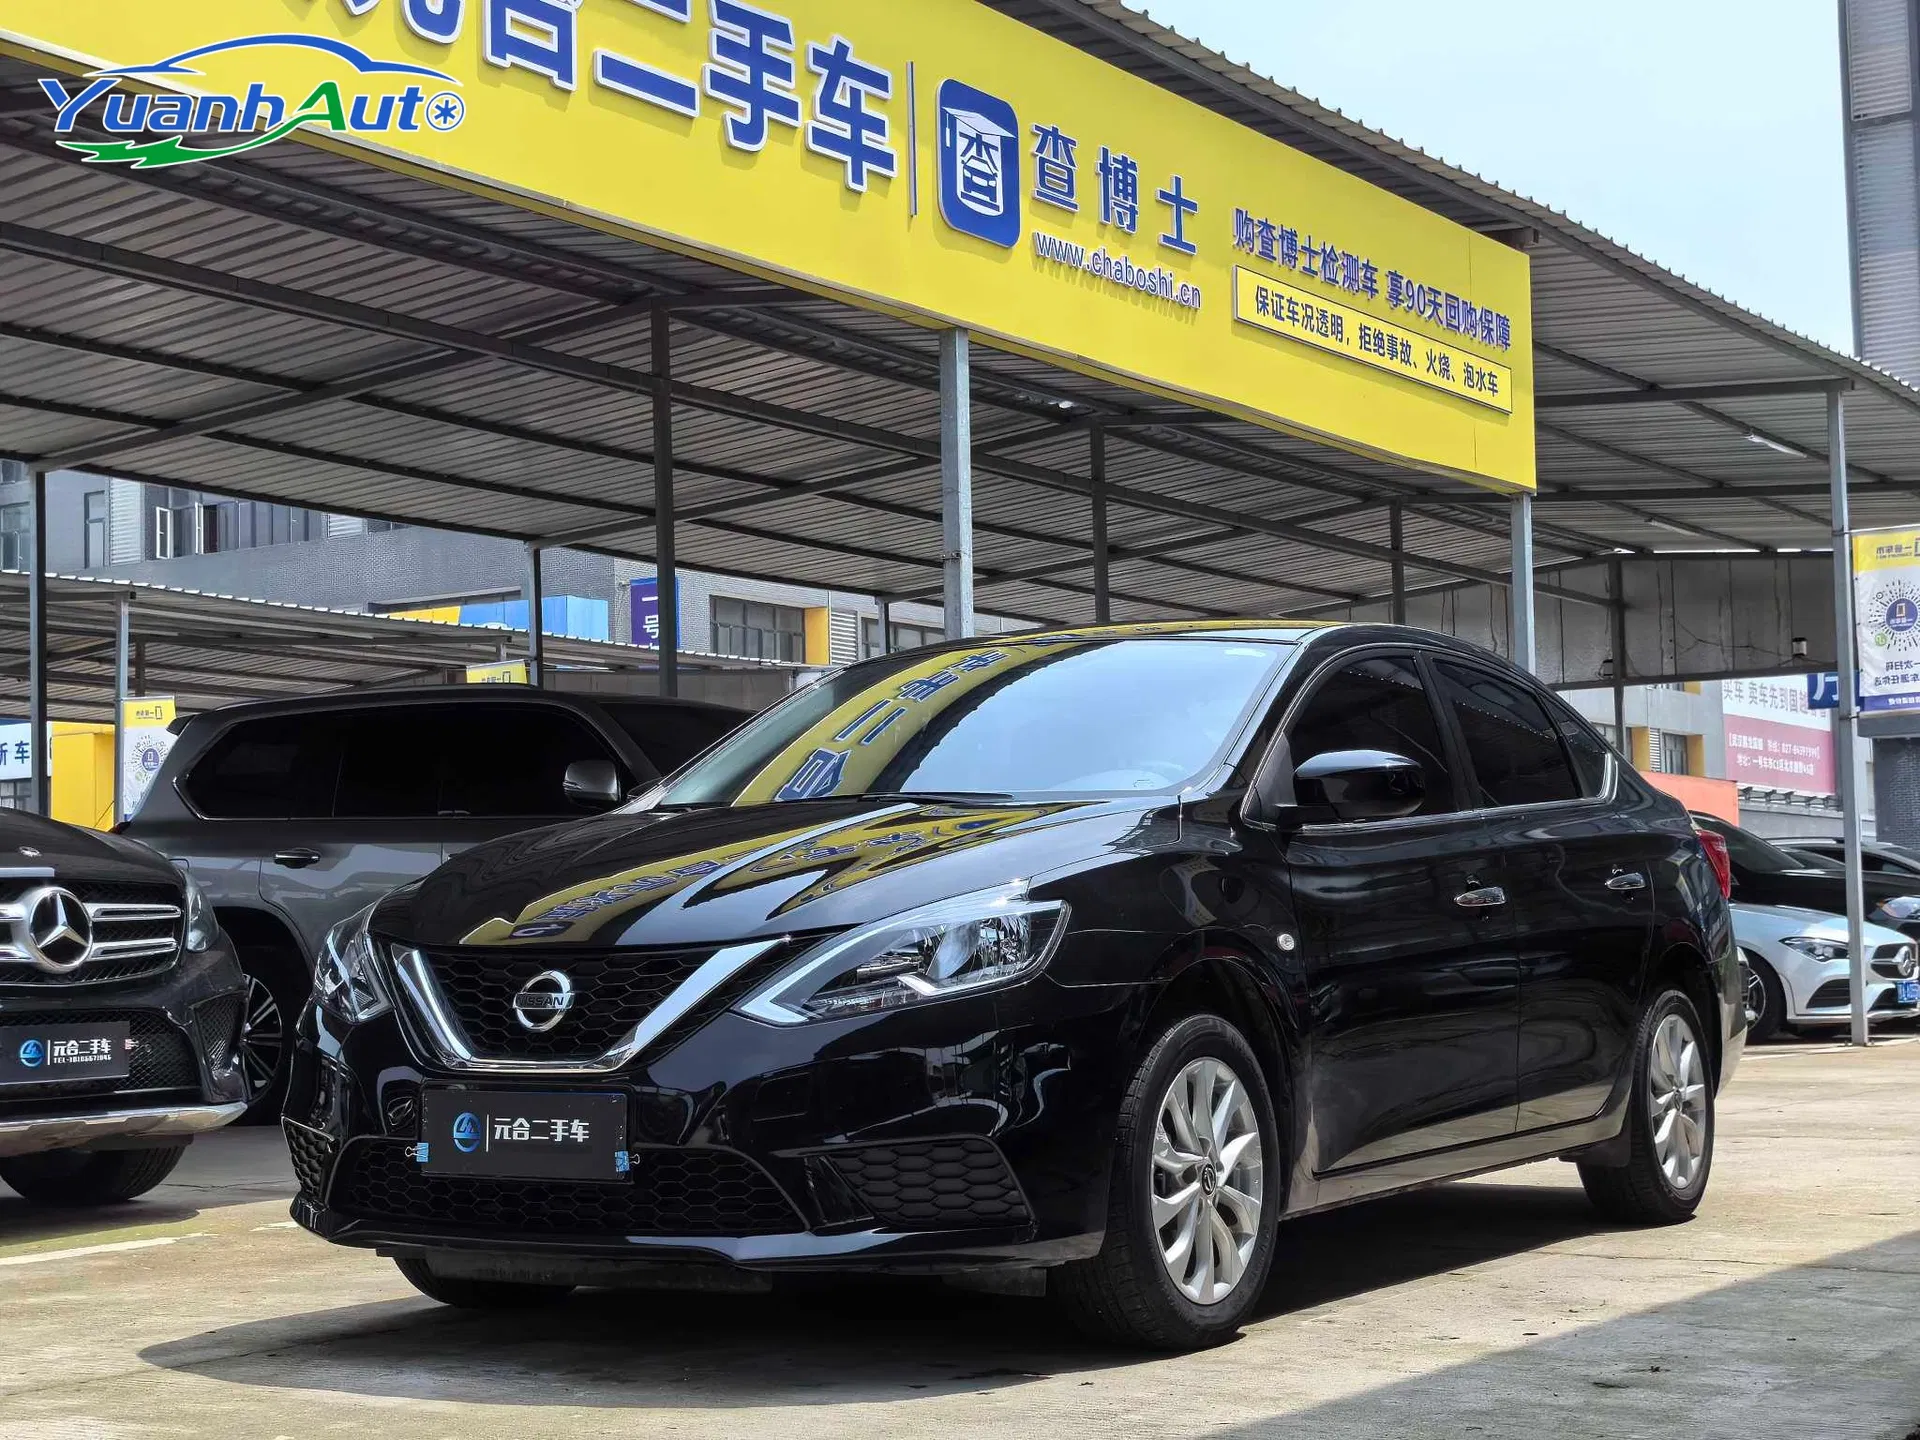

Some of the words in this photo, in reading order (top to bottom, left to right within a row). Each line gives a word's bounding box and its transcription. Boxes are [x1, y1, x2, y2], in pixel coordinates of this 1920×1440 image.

[1030, 123, 1199, 256] 查博士
[1033, 231, 1202, 310] www.chaboshi.cn
[1232, 207, 1380, 300] 购查博士检测车
[1384, 270, 1512, 351] 享90天回购保障
[516, 995, 565, 1006] NISSAN
[53, 1038, 112, 1057] 元合二手车
[494, 1118, 590, 1143] 元合二手车
